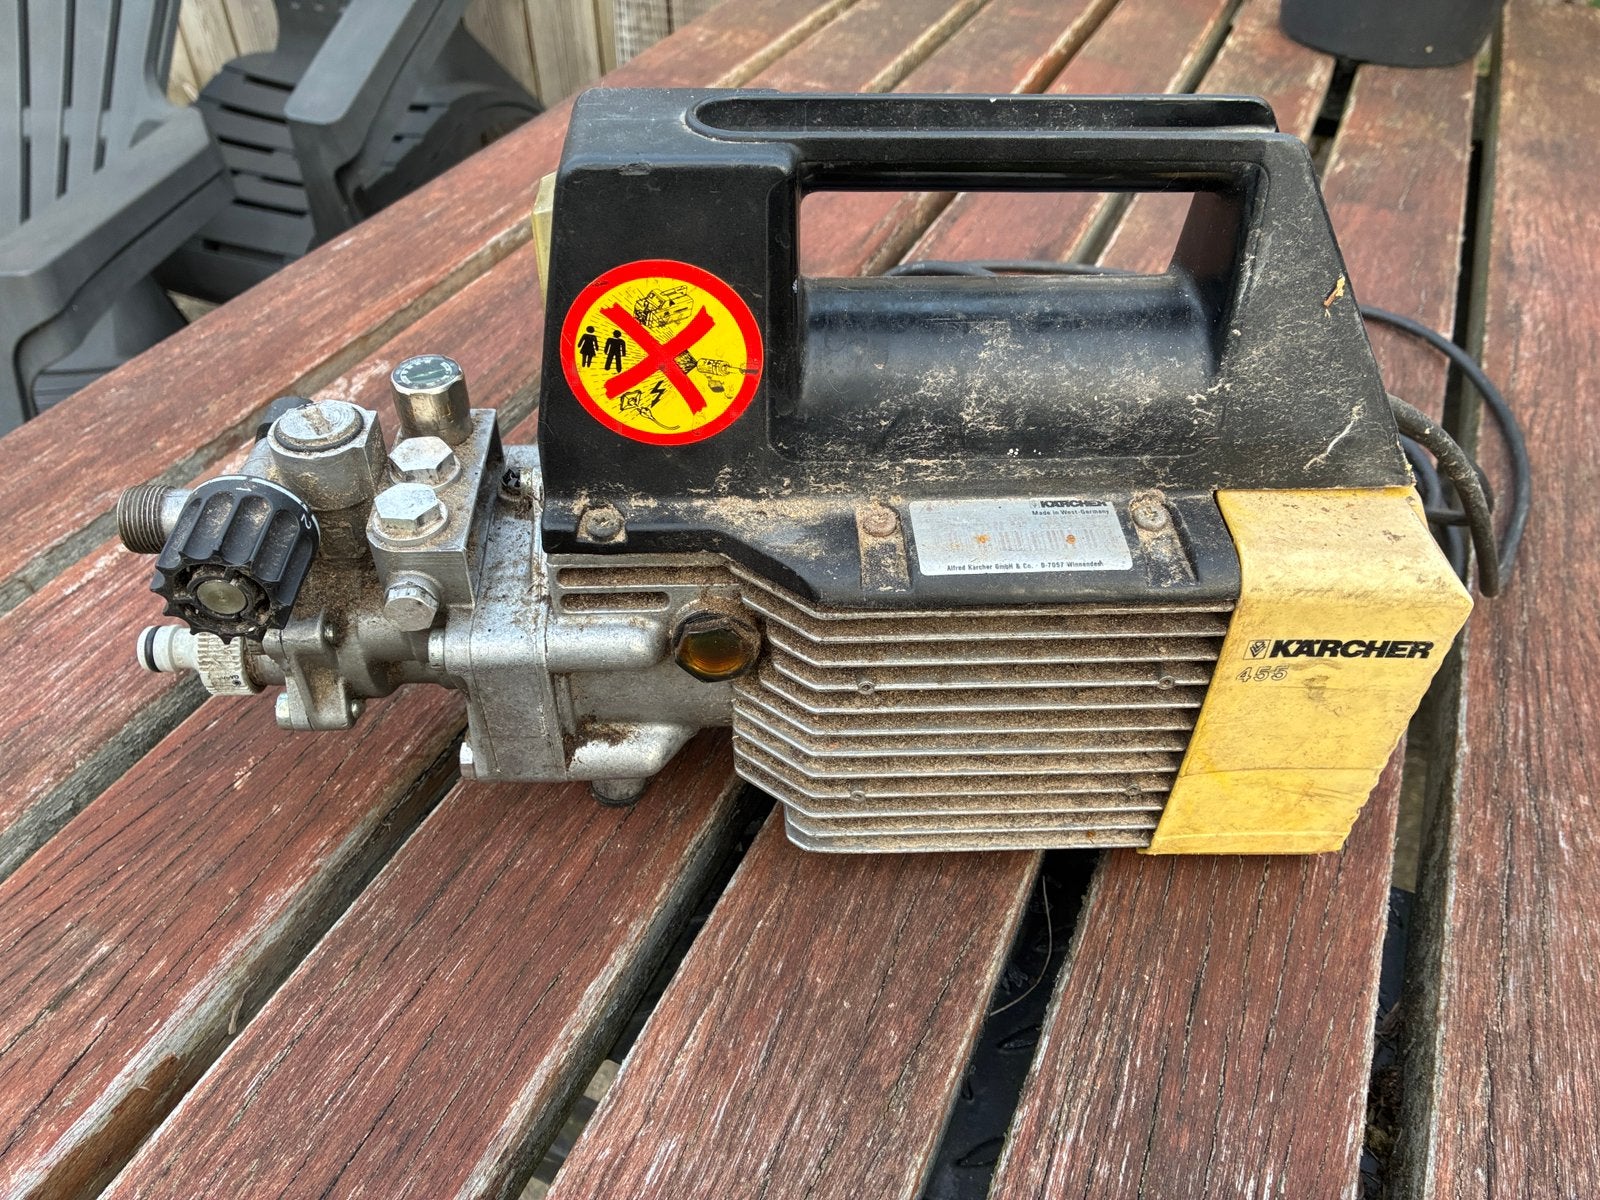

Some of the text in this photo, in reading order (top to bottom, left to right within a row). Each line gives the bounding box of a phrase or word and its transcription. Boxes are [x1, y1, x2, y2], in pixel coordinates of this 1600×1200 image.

[946, 564, 966, 572] Alfred
[1269, 639, 1435, 659] KÄRCHER
[1236, 664, 1290, 683] 455
